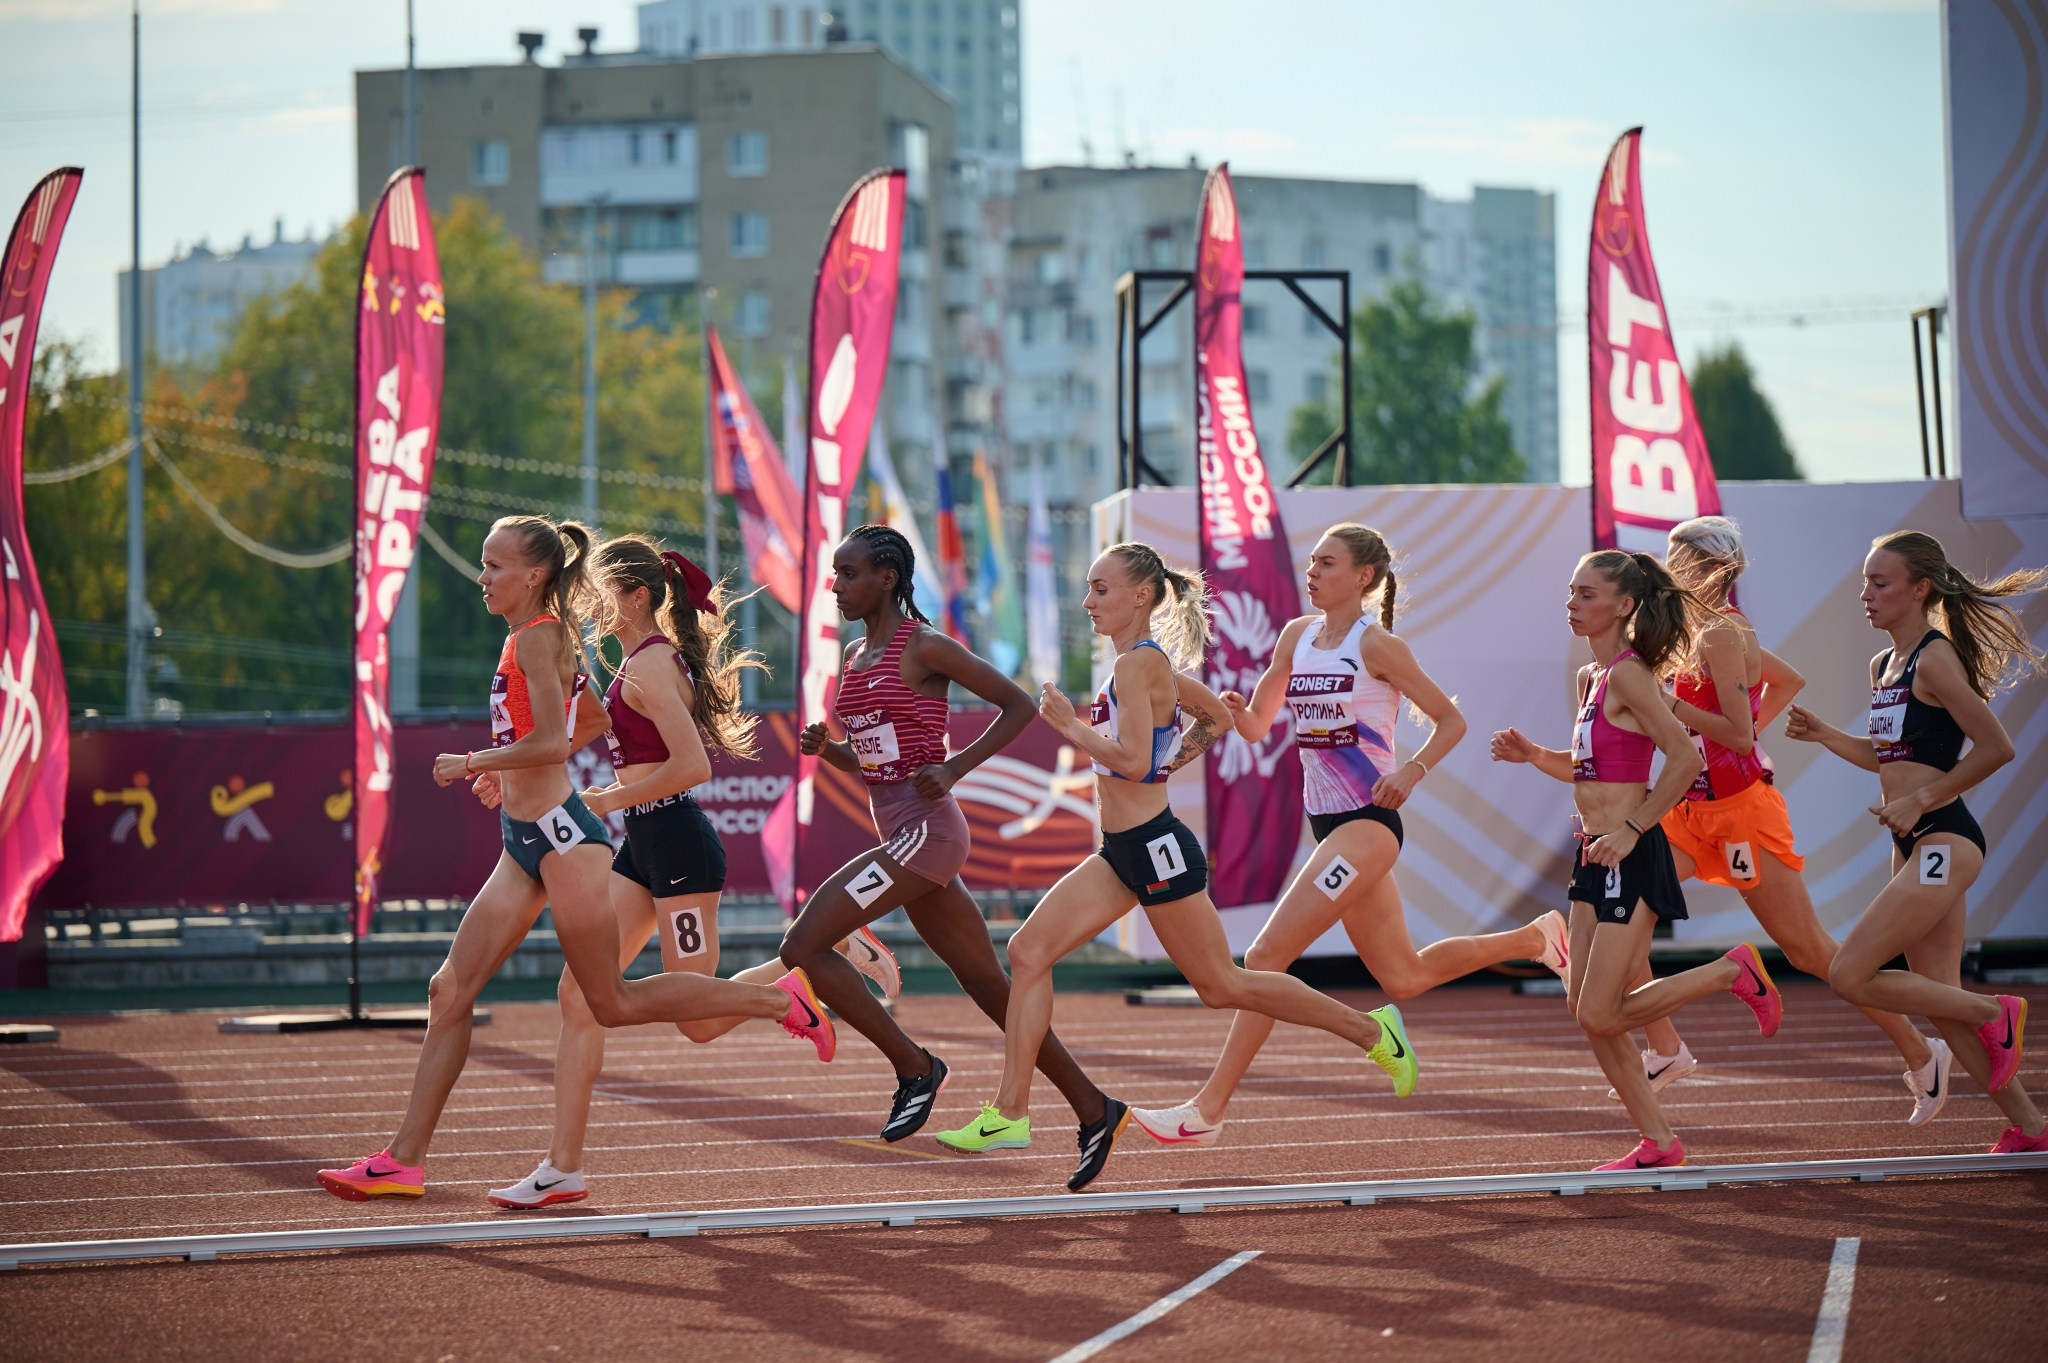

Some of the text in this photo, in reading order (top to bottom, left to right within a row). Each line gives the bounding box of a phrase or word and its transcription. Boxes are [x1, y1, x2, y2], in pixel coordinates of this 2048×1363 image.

[1213, 375, 1275, 541] РОССИИ
[1289, 676, 1346, 691] FONBET
[841, 709, 883, 729] FONBET
[1292, 702, 1346, 719] РОПИНА
[636, 796, 676, 816] NIKE
[552, 816, 573, 843] 6
[1157, 843, 1176, 870] 1
[1732, 849, 1749, 873] 4
[1926, 851, 1944, 878] 2
[856, 869, 885, 894] 7
[1324, 864, 1350, 890] 5
[675, 912, 702, 953] 8
